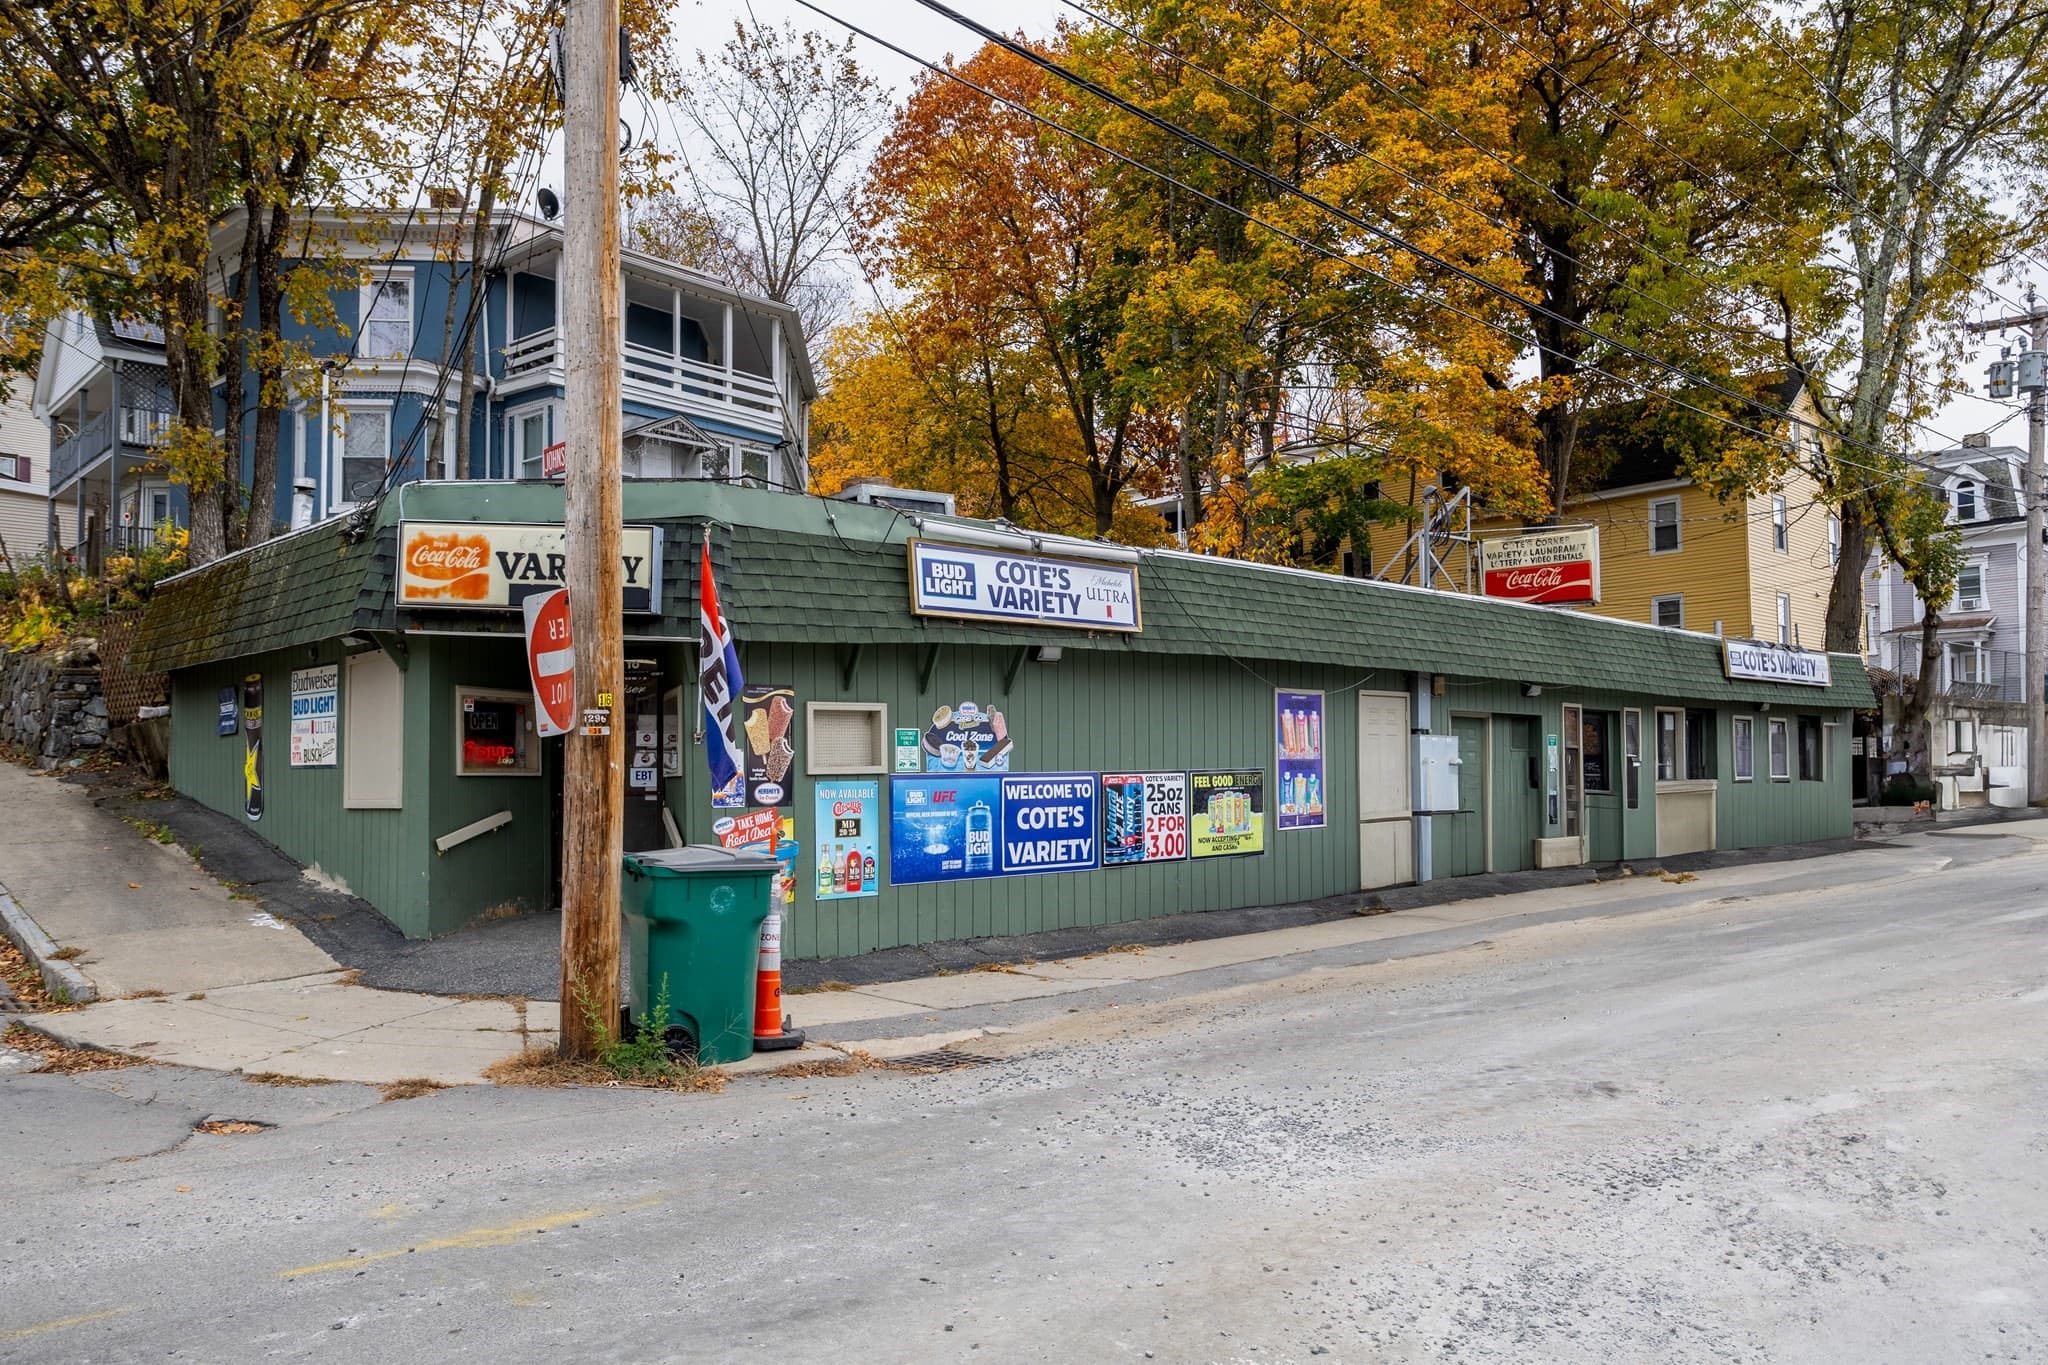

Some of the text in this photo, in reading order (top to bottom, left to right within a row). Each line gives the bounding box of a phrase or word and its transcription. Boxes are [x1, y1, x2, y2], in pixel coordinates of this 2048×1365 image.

[412, 545, 484, 569] Coca-Cola
[1486, 549, 1522, 560] VARIETY
[1531, 555, 1552, 564] VIDEO
[1553, 552, 1584, 561] RENTALS
[496, 551, 643, 584] VARY
[931, 562, 967, 580] BUD
[995, 560, 1071, 591] COTE'S
[1506, 566, 1564, 590] Coca-Cola
[925, 577, 975, 597] LIGHT
[1086, 586, 1130, 604] ULTRA
[987, 584, 1081, 616] VARIETY
[1742, 650, 1777, 673] COTE'S
[1776, 653, 1816, 678] VARIETY
[292, 670, 337, 693] Budweiser
[293, 695, 335, 716] BUD LIGHT
[599, 693, 613, 707] 16
[315, 720, 336, 736] ULTRA
[472, 713, 498, 729] OPEN
[946, 731, 994, 742] Cool Zone
[304, 746, 322, 764] BUSCH
[635, 771, 654, 781] EBT
[1194, 776, 1211, 788] FEEL
[1212, 775, 1233, 787] GOOD
[820, 788, 875, 799] NOW AVAILABLE
[932, 790, 957, 803] UFC
[1006, 783, 1091, 800] WELCOME TO
[1146, 783, 1184, 802] 25oz
[1151, 802, 1181, 815] CANS
[736, 816, 755, 830] TAKE
[755, 810, 775, 825] HOME
[841, 820, 855, 829] MD
[1017, 805, 1084, 830] COTE'S
[1146, 816, 1184, 832] 2 FOR
[725, 831, 750, 848] Real
[968, 831, 990, 842] BUD
[1146, 832, 1185, 858] $3.00
[1211, 835, 1238, 843] ACCEPTING
[1008, 838, 1092, 865] VARIETY
